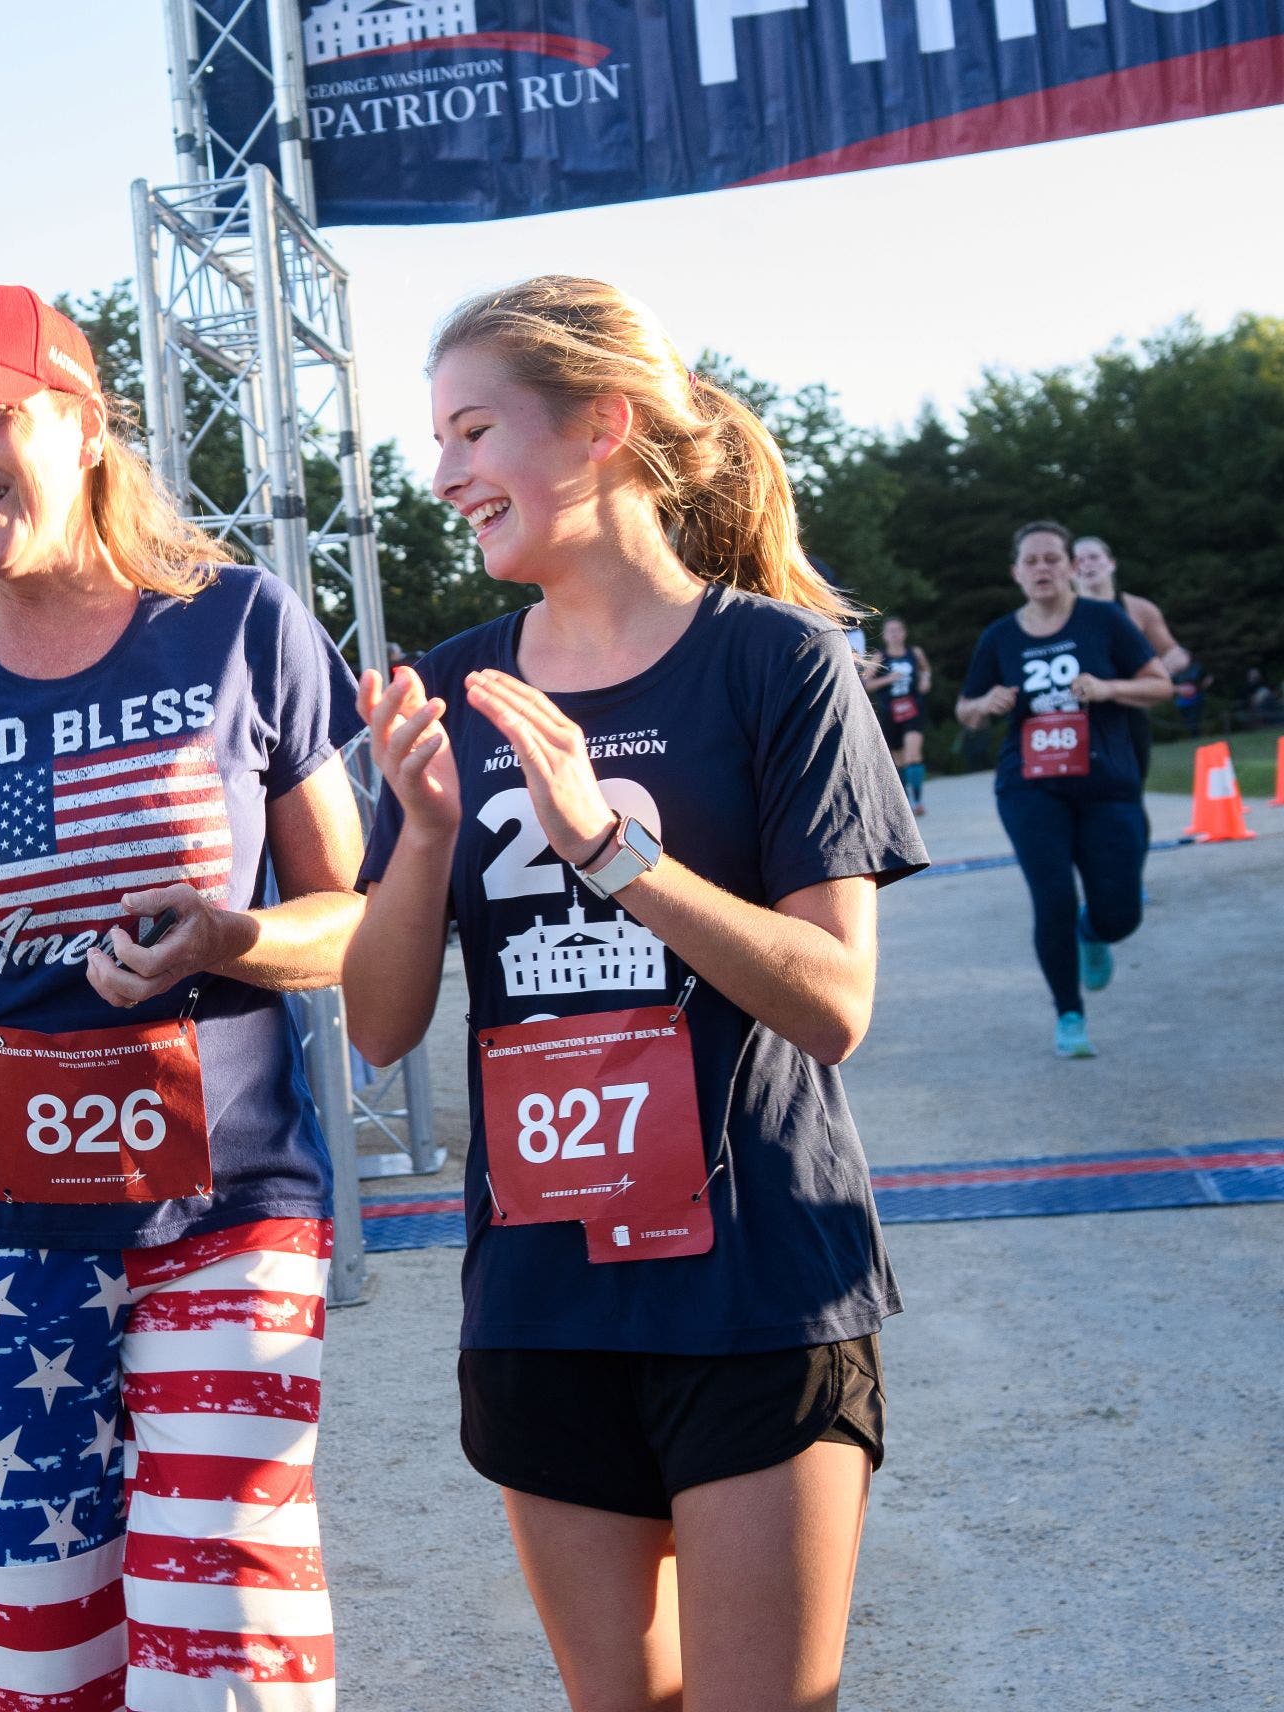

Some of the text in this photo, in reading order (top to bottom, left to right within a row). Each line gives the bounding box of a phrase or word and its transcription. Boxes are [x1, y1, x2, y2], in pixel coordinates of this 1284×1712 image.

[307, 58, 504, 99] GEORGE WASHINGTON
[308, 64, 620, 142] PATRIOT RUN
[1022, 654, 1080, 692] 20
[52, 683, 215, 756] BLESS
[1031, 727, 1078, 752] 848
[483, 740, 667, 773] MOU ERNON
[34, 1048, 102, 1060] WASHINGTON
[105, 1043, 149, 1057] PATRIOT
[151, 1039, 172, 1051] RUN
[487, 1045, 523, 1058] GEORGE
[523, 1038, 585, 1053] WASHINGTON
[586, 1031, 632, 1045] PATRIOT
[634, 1028, 660, 1039] RUN
[58, 1061, 97, 1069] SEPTEMBER
[26, 1088, 167, 1154] 826
[517, 1081, 650, 1163] 827
[542, 1186, 612, 1198] LOCKHEED MARTIN
[646, 1230, 667, 1238] FREE
[668, 1228, 689, 1236] BEER
